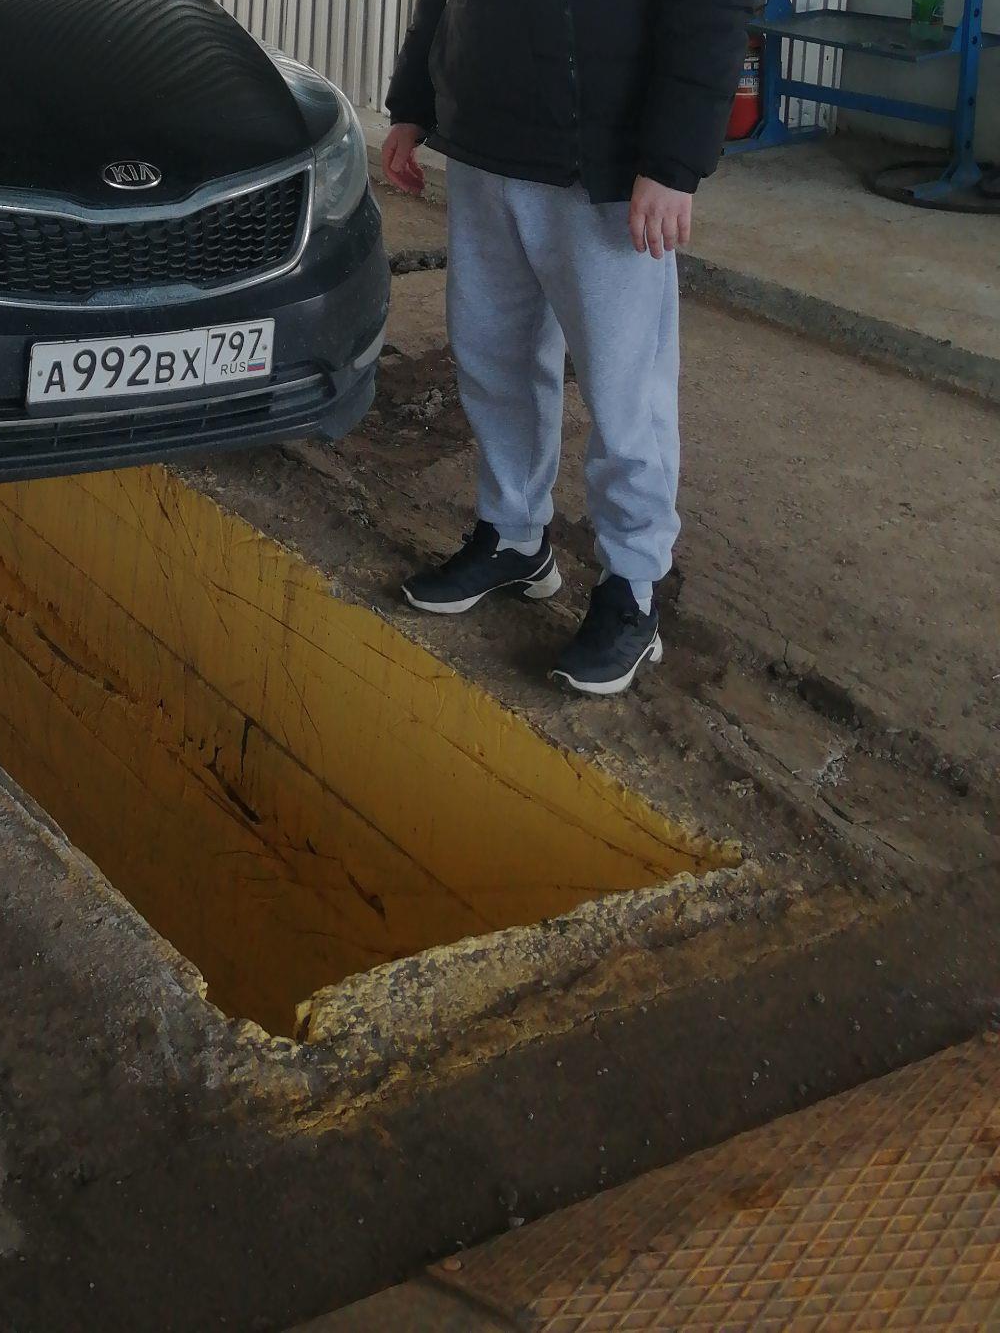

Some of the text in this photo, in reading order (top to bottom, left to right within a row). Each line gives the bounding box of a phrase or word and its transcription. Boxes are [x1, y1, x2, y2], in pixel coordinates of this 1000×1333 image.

[110, 164, 156, 182] KIA
[44, 328, 263, 394] A992BX 797
[221, 362, 246, 376] RUS
